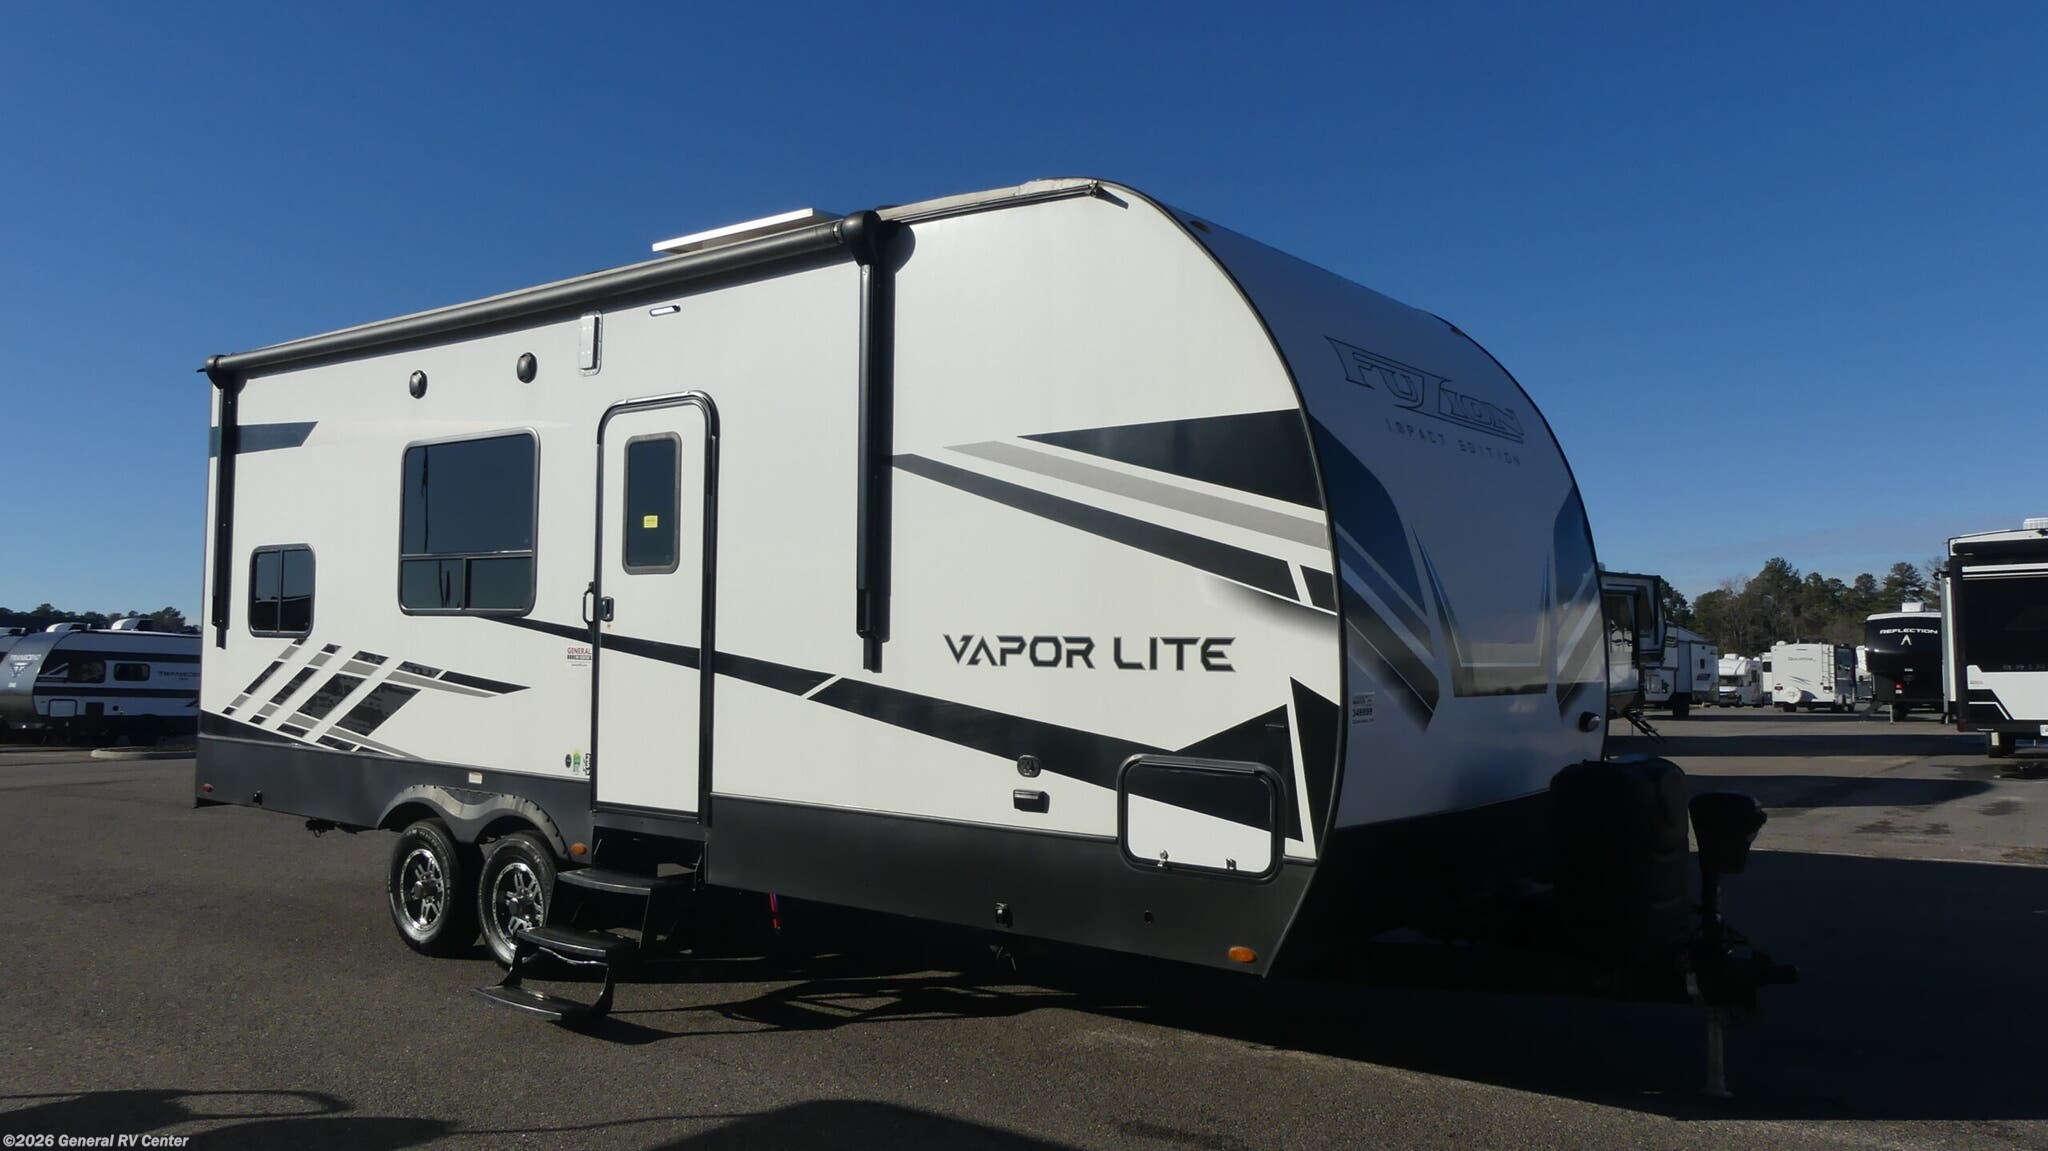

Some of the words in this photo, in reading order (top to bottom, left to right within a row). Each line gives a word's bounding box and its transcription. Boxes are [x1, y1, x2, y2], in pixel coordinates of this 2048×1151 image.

[1457, 438, 1521, 466] EDITION
[566, 647, 592, 655] GENERAL
[943, 634, 1096, 669] VAPOR
[1113, 636, 1236, 672] LITE
